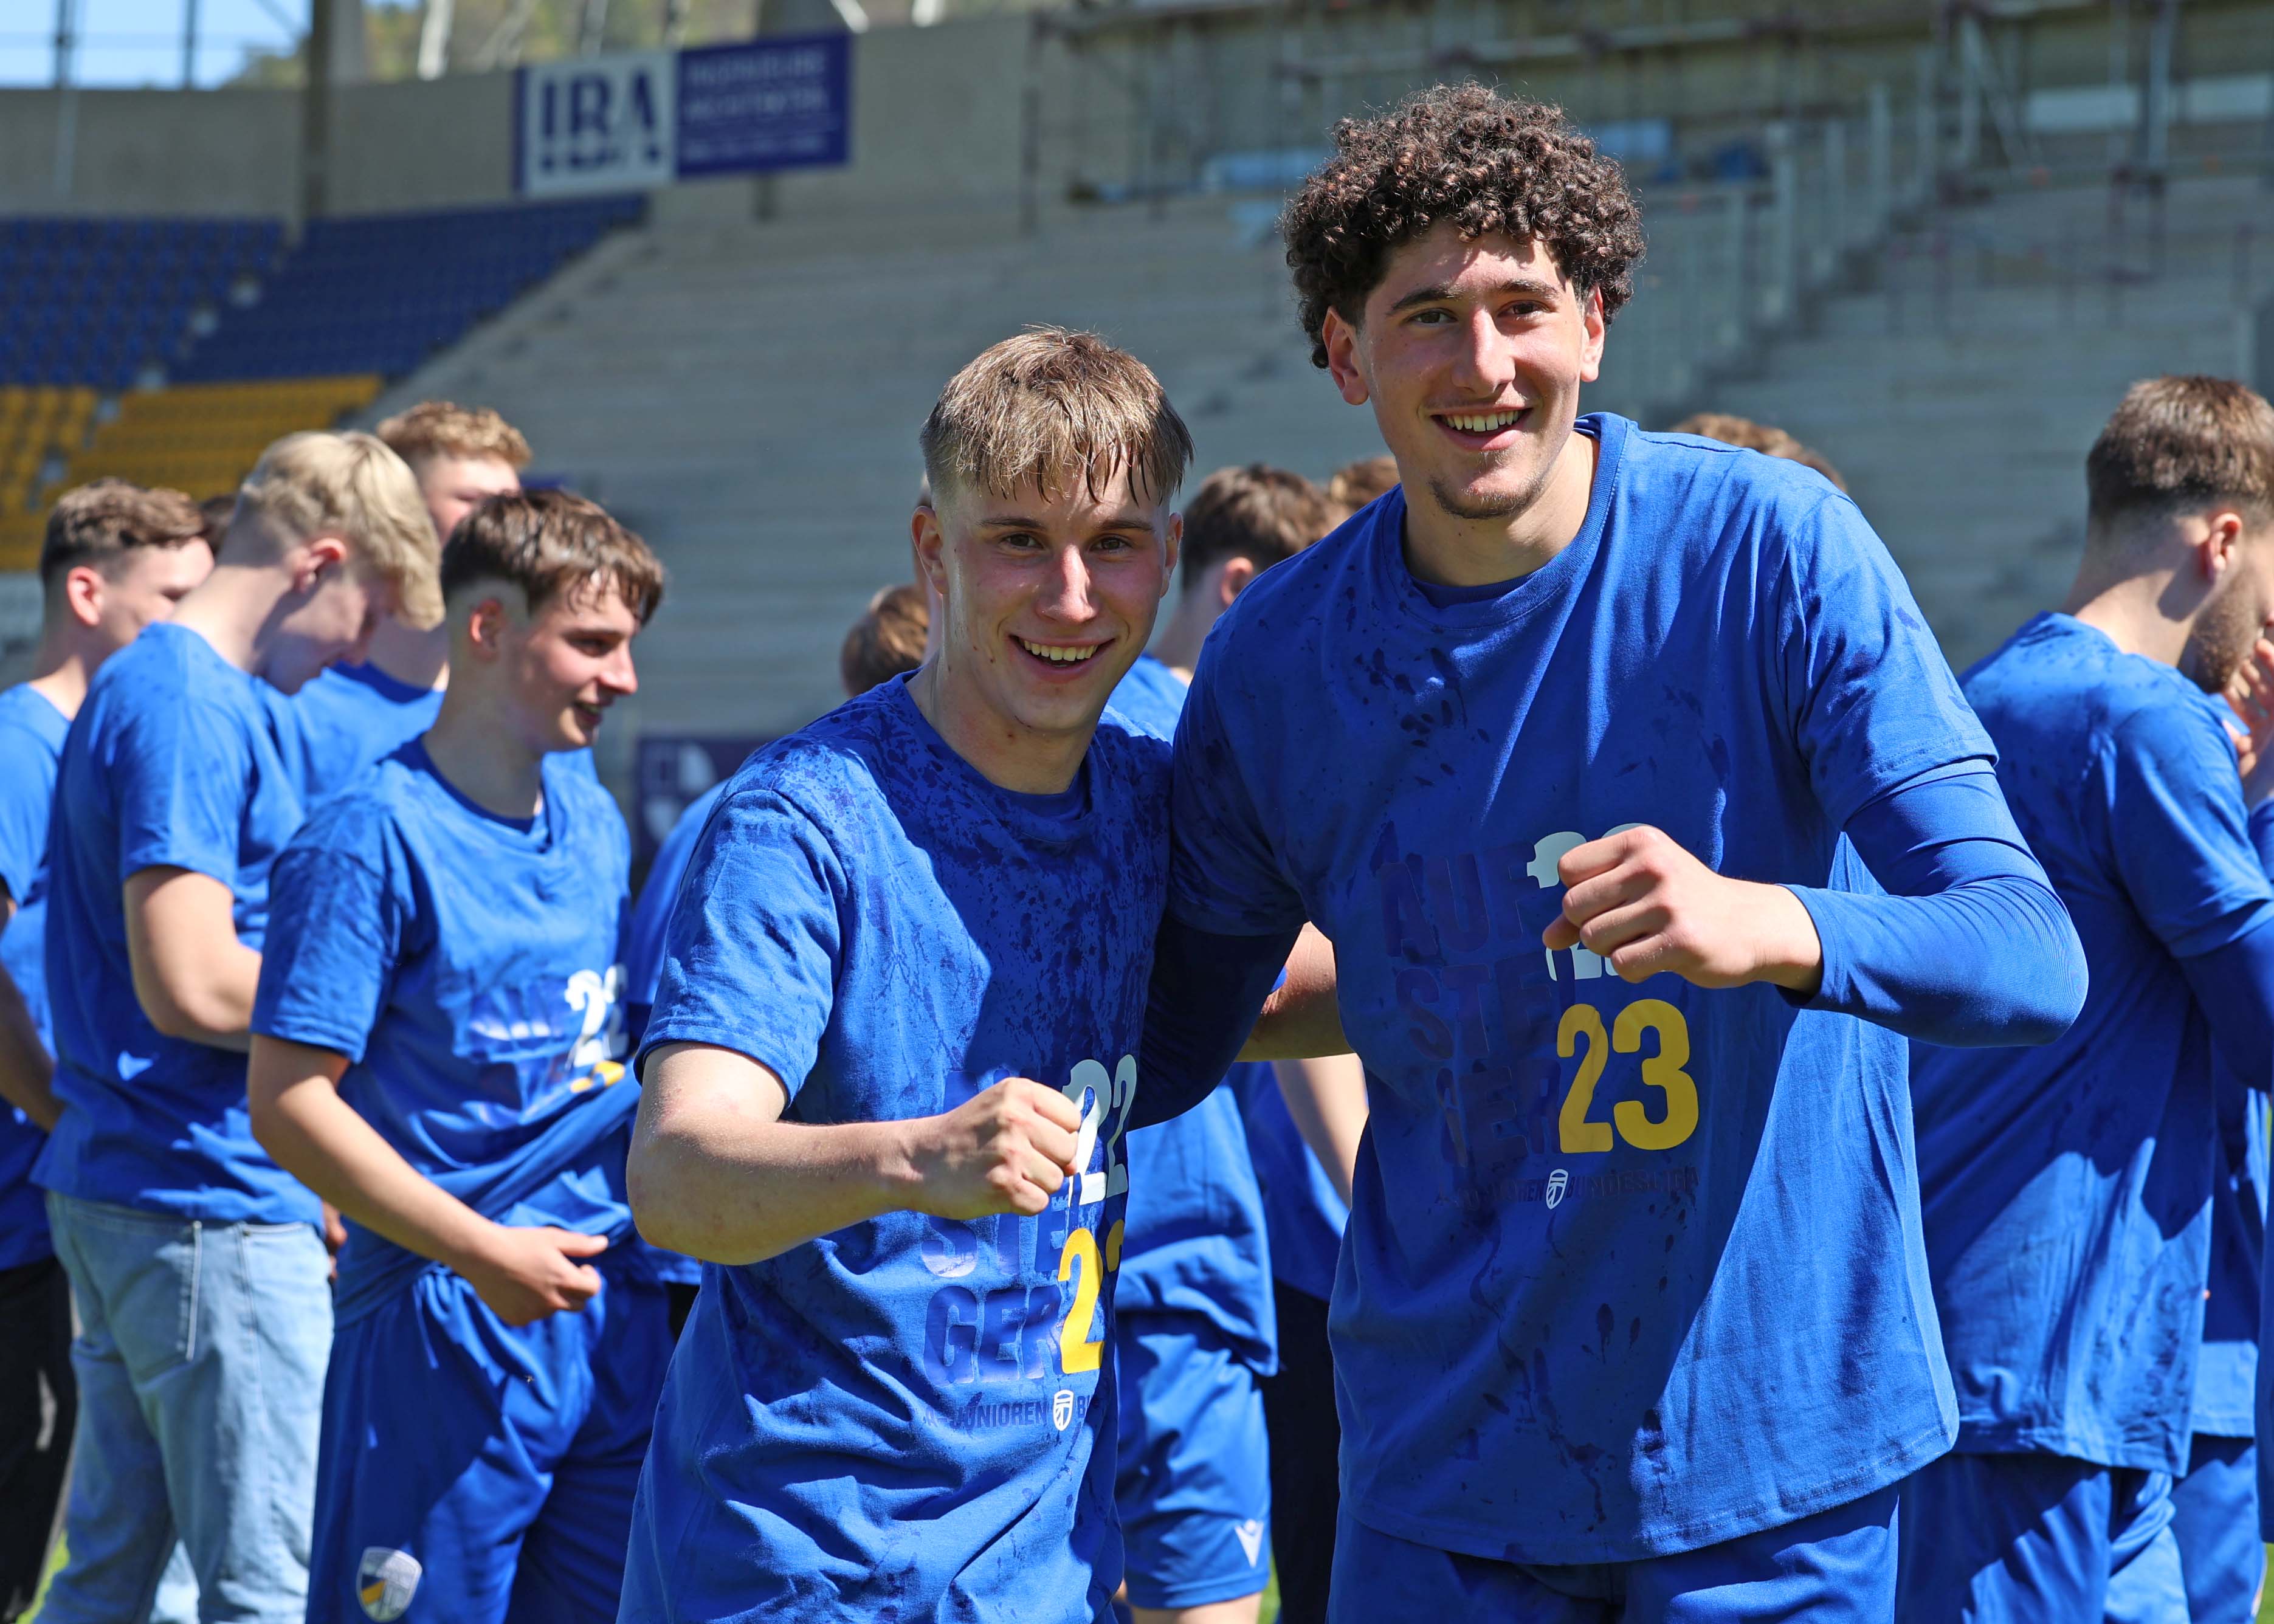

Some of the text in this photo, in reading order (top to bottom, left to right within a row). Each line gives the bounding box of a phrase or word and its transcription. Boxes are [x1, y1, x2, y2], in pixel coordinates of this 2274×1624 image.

[1062, 1053, 1137, 1207] 22
[1556, 999, 1699, 1154] 23
[923, 1285, 1061, 1385] GER
